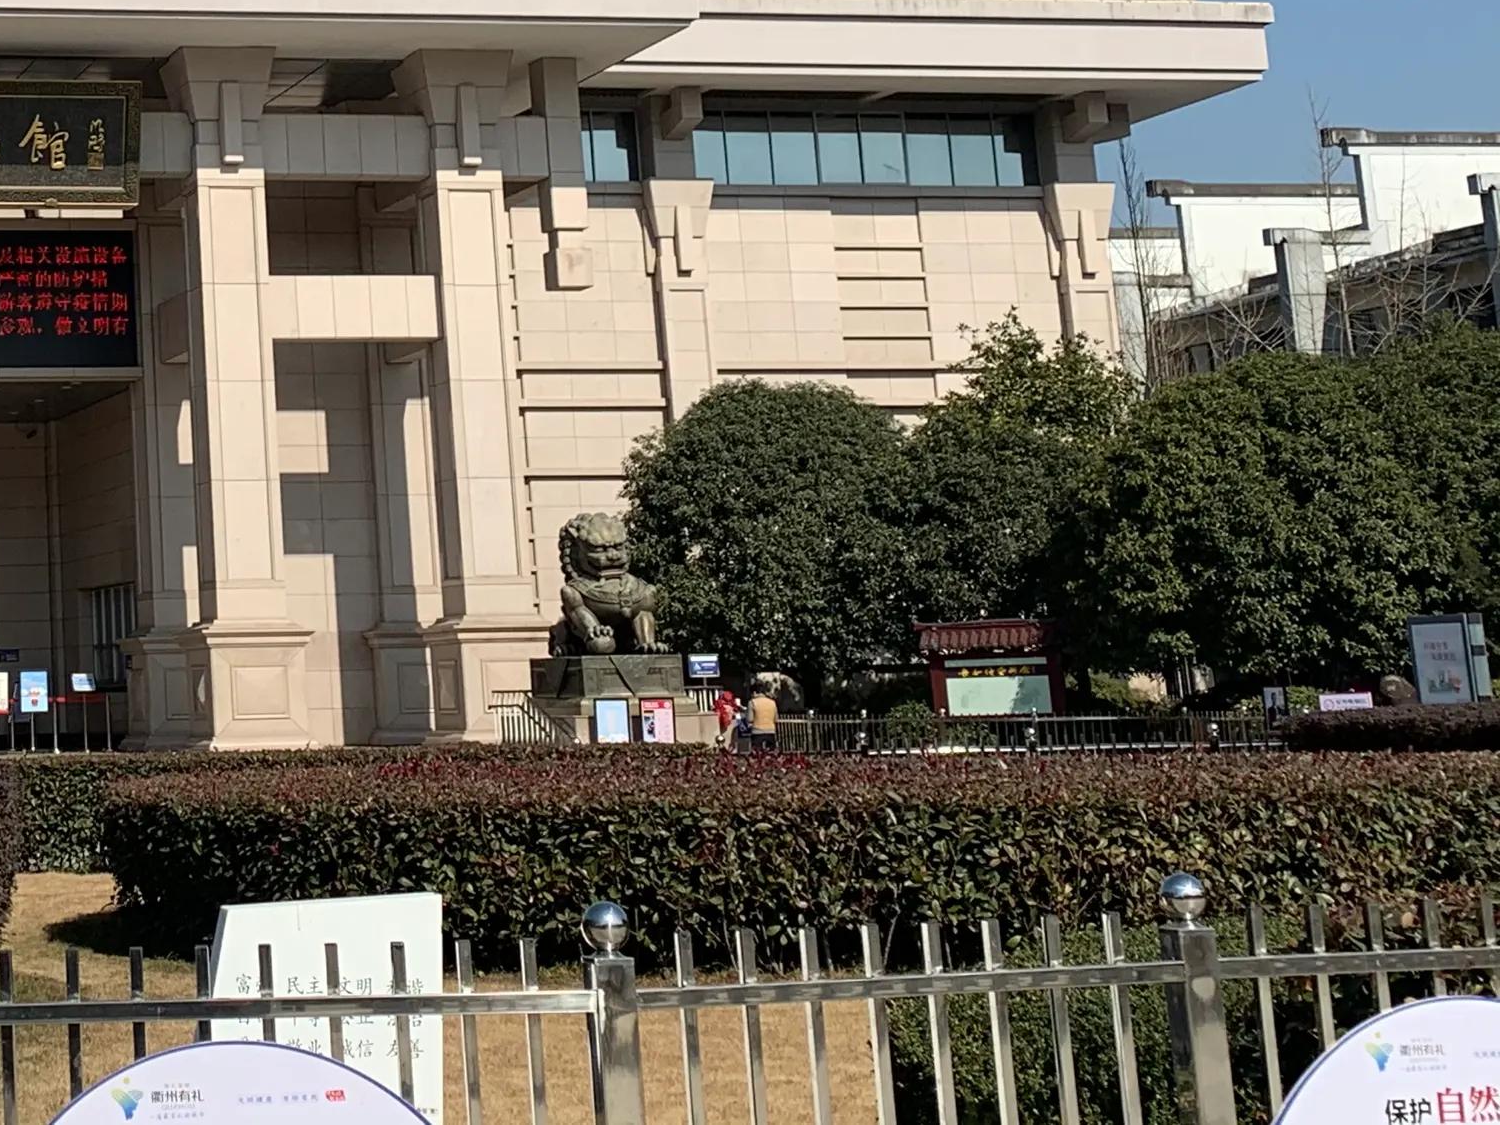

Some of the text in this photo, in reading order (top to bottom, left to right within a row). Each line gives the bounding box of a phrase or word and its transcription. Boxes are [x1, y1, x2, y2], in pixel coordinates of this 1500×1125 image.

[287, 976, 324, 995] 民主
[339, 976, 373, 995] 文明
[151, 1089, 204, 1103] 衢州有礼
